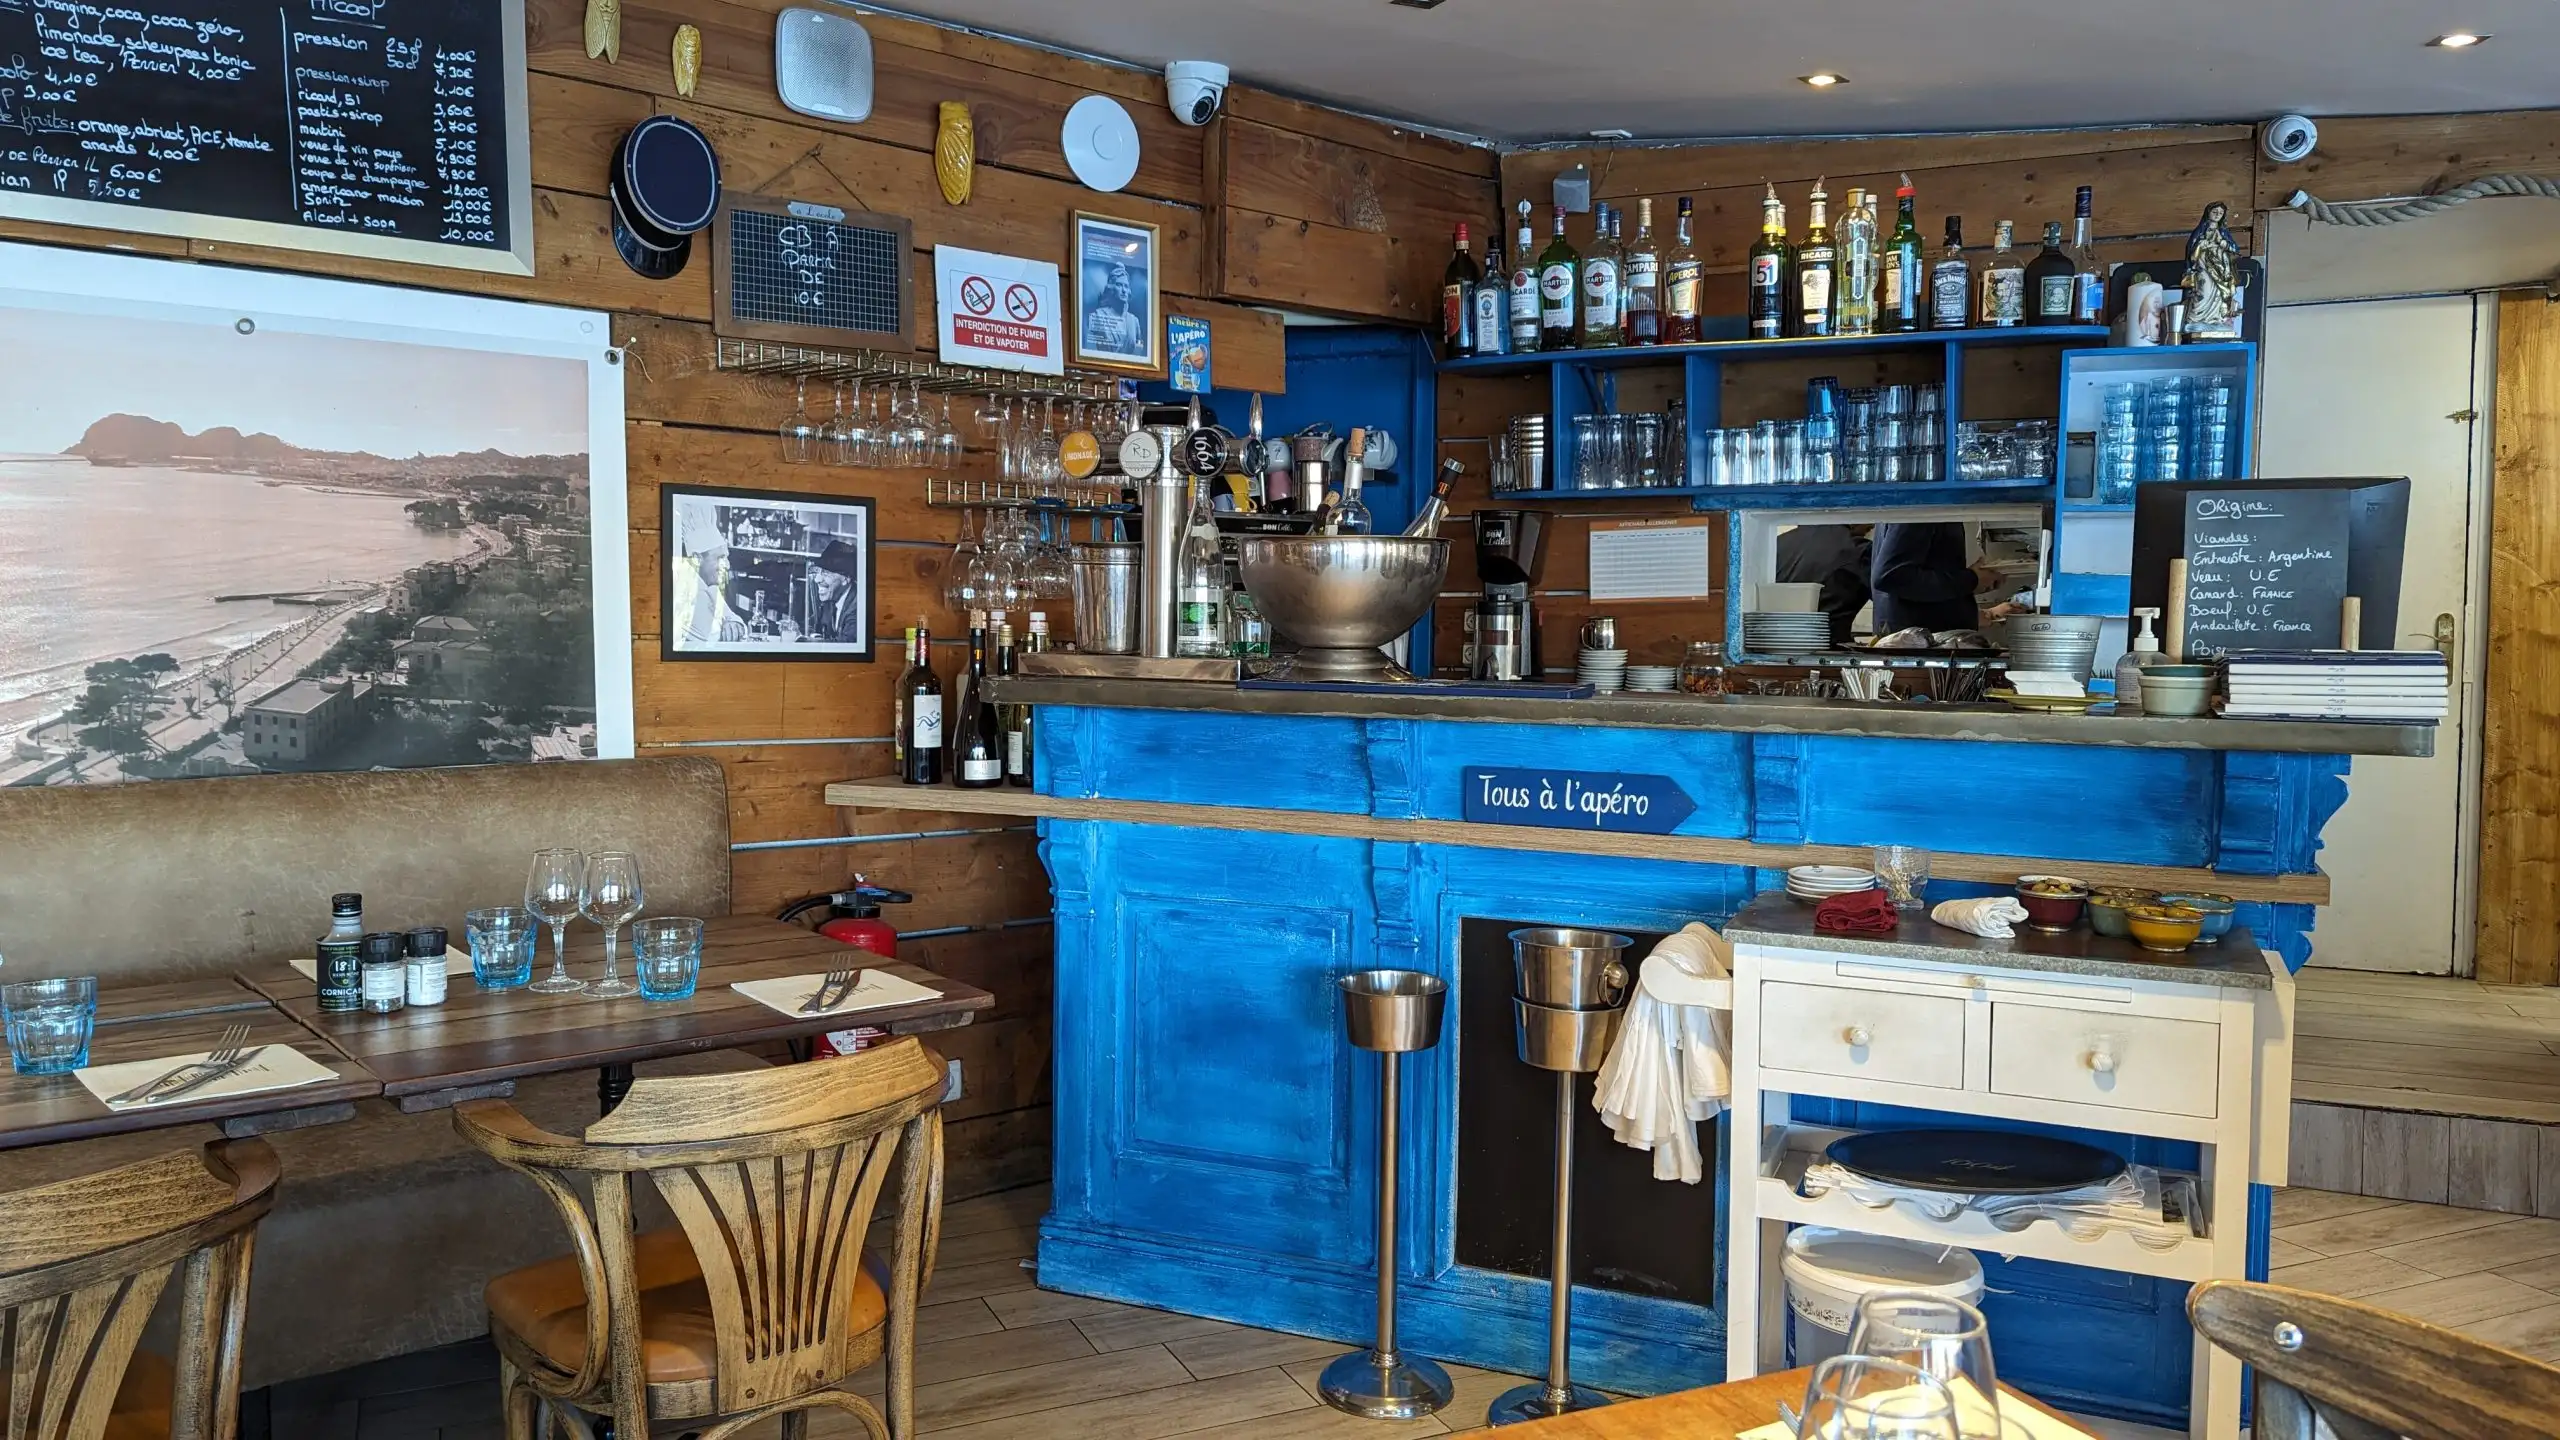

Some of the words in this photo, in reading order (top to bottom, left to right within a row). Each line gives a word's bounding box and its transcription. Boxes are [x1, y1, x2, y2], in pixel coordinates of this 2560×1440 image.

[151, 14, 194, 30] coca
[294, 32, 368, 53] pression
[40, 41, 69, 59] ice
[188, 62, 241, 80] 4,00€
[213, 46, 256, 70] tonic
[44, 65, 98, 86] 4,10€
[433, 62, 475, 79] 7,30€
[24, 85, 77, 102] 3,00€
[344, 93, 361, 106] 51
[433, 103, 475, 117] 3,60€
[299, 120, 346, 138] martini
[434, 138, 477, 152] 5,10€
[433, 119, 478, 134] 3,70€
[225, 130, 274, 151] tomate
[148, 142, 200, 161] 4,00€
[332, 138, 348, 153] de
[351, 145, 369, 155] vin
[373, 148, 403, 163] pays
[436, 151, 477, 166] 4,90€
[109, 164, 162, 183] 6,00€
[334, 152, 350, 166] de
[352, 158, 370, 169] vin
[437, 166, 477, 181] 7,90€
[300, 167, 337, 183] coupe
[341, 167, 357, 181] de
[362, 169, 430, 194] champagne
[300, 182, 372, 199] americano
[377, 194, 425, 207] maison
[443, 199, 492, 213] 10,00€
[303, 208, 345, 223] Alcool
[440, 227, 495, 242] 10,00€
[779, 225, 812, 248] CB
[799, 269, 825, 285] DE
[1586, 274, 1613, 284] MARTINI
[1668, 268, 1699, 284] APEROL
[1757, 265, 1774, 284] 51
[955, 318, 1008, 335] INTERDICTION
[1008, 326, 1018, 336] DE
[1019, 328, 1045, 340] FUMER
[1171, 329, 1206, 344] L'APÉRO
[973, 334, 984, 344] ET
[984, 336, 996, 345] DE
[996, 337, 1030, 351] VAPOTER
[1194, 435, 1216, 473] 1664
[2267, 546, 2333, 568] Argentine
[2272, 619, 2313, 633] France
[1478, 773, 1531, 809] Tous
[1539, 776, 1558, 811] à
[1564, 777, 1650, 826] l'apéro
